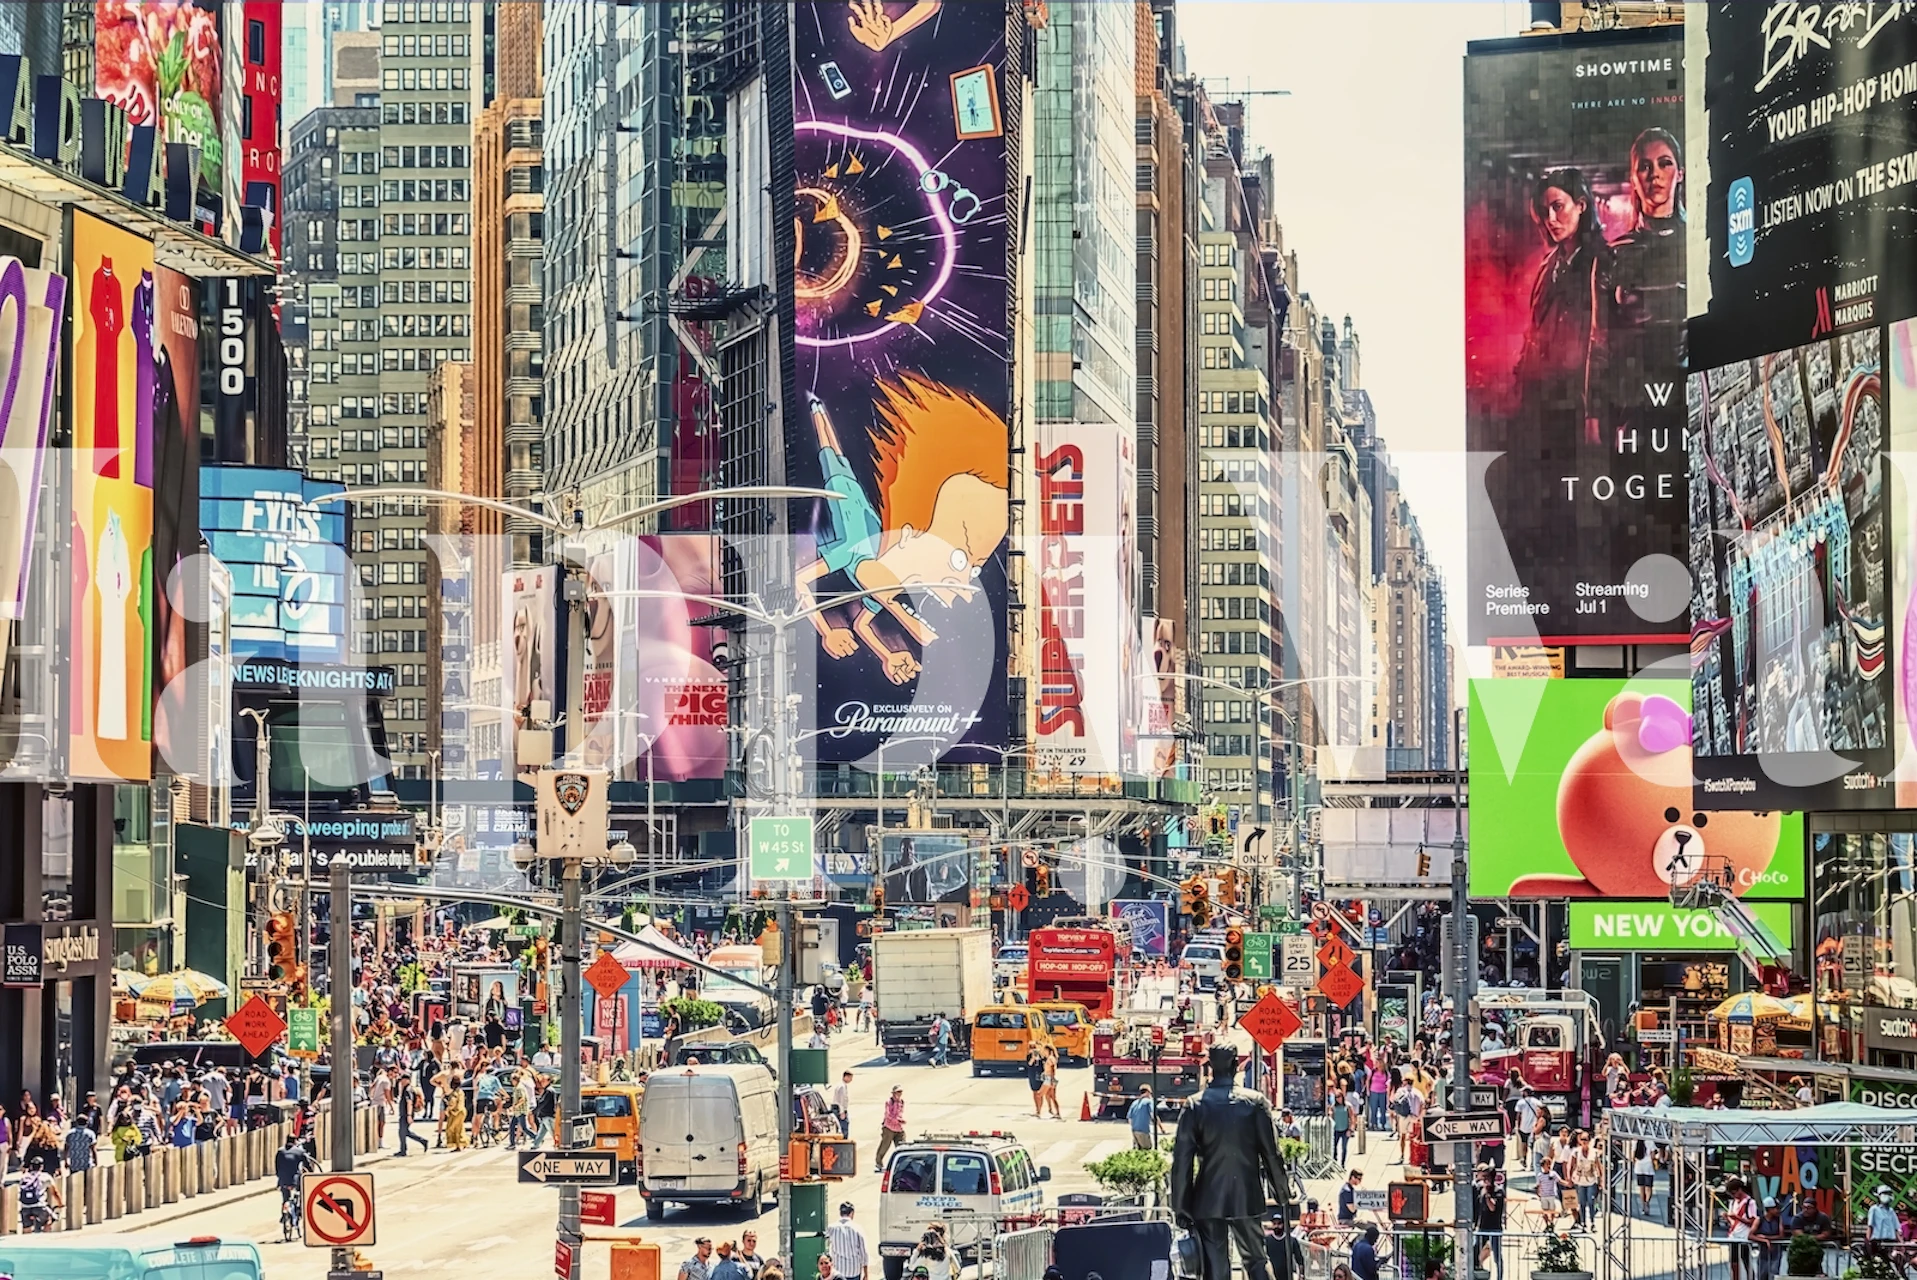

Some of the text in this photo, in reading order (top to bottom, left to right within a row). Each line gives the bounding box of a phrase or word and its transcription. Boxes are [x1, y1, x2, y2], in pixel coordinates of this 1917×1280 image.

[1576, 58, 1672, 77] SHOWTIME
[164, 98, 203, 119] ONLY ON
[1571, 101, 1602, 109] THERE
[1608, 99, 1625, 107] ARE
[1632, 97, 1645, 105] NO
[1767, 104, 1807, 143] YOUR
[1811, 79, 1878, 128] HIP-HOP
[165, 115, 203, 147] Uber
[1764, 194, 1802, 228] LISTEN
[1805, 184, 1833, 214] NOW
[1835, 177, 1853, 205] ON
[1856, 162, 1885, 198] THE
[1730, 208, 1753, 235] sxm
[1834, 275, 1879, 301] MARRIOTT
[1834, 301, 1874, 326] MARQUIS
[220, 278, 244, 395] 1500
[1561, 473, 1690, 500] TOGE
[1486, 584, 1530, 599] Series
[1575, 582, 1649, 598] Streaming
[1486, 602, 1550, 615] Premiere
[1575, 600, 1607, 614] Jul 1
[231, 664, 275, 684] NEWS
[665, 685, 727, 693] THE NEXT
[665, 693, 727, 713] PIG
[873, 704, 952, 714] EXCLUSIVELY ON
[665, 714, 727, 726] THING
[1069, 755, 1087, 766] 29
[294, 819, 380, 840] sweeping
[774, 824, 790, 837] TO
[760, 841, 804, 853] W 45 St
[1242, 855, 1269, 864] ONLY
[525, 926, 534, 935] 45
[1281, 922, 1292, 931] 45
[1594, 913, 1664, 937] NEW
[80, 925, 99, 960] hut
[1057, 933, 1086, 943] TOPVIEW
[7, 945, 28, 956] U.S.
[7, 955, 38, 966] POLO
[1040, 962, 1104, 972] HOP-ON HOP-OFF
[1287, 956, 1311, 970] 25
[7, 966, 40, 976] ASSN.
[244, 1011, 268, 1019] ROAD
[1258, 1007, 1282, 1015] ROAD
[242, 1030, 270, 1038] AHEAD
[1256, 1028, 1285, 1036] AHEAD
[1880, 1017, 1911, 1038] swatch
[294, 1031, 313, 1039] South
[1474, 1094, 1492, 1104] WAY
[1435, 1121, 1495, 1134] ONE WAY
[532, 1159, 605, 1174] ONE WAY
[1356, 1191, 1386, 1200] PEDESTRIAN
[149, 1252, 197, 1269] COMPLETE
